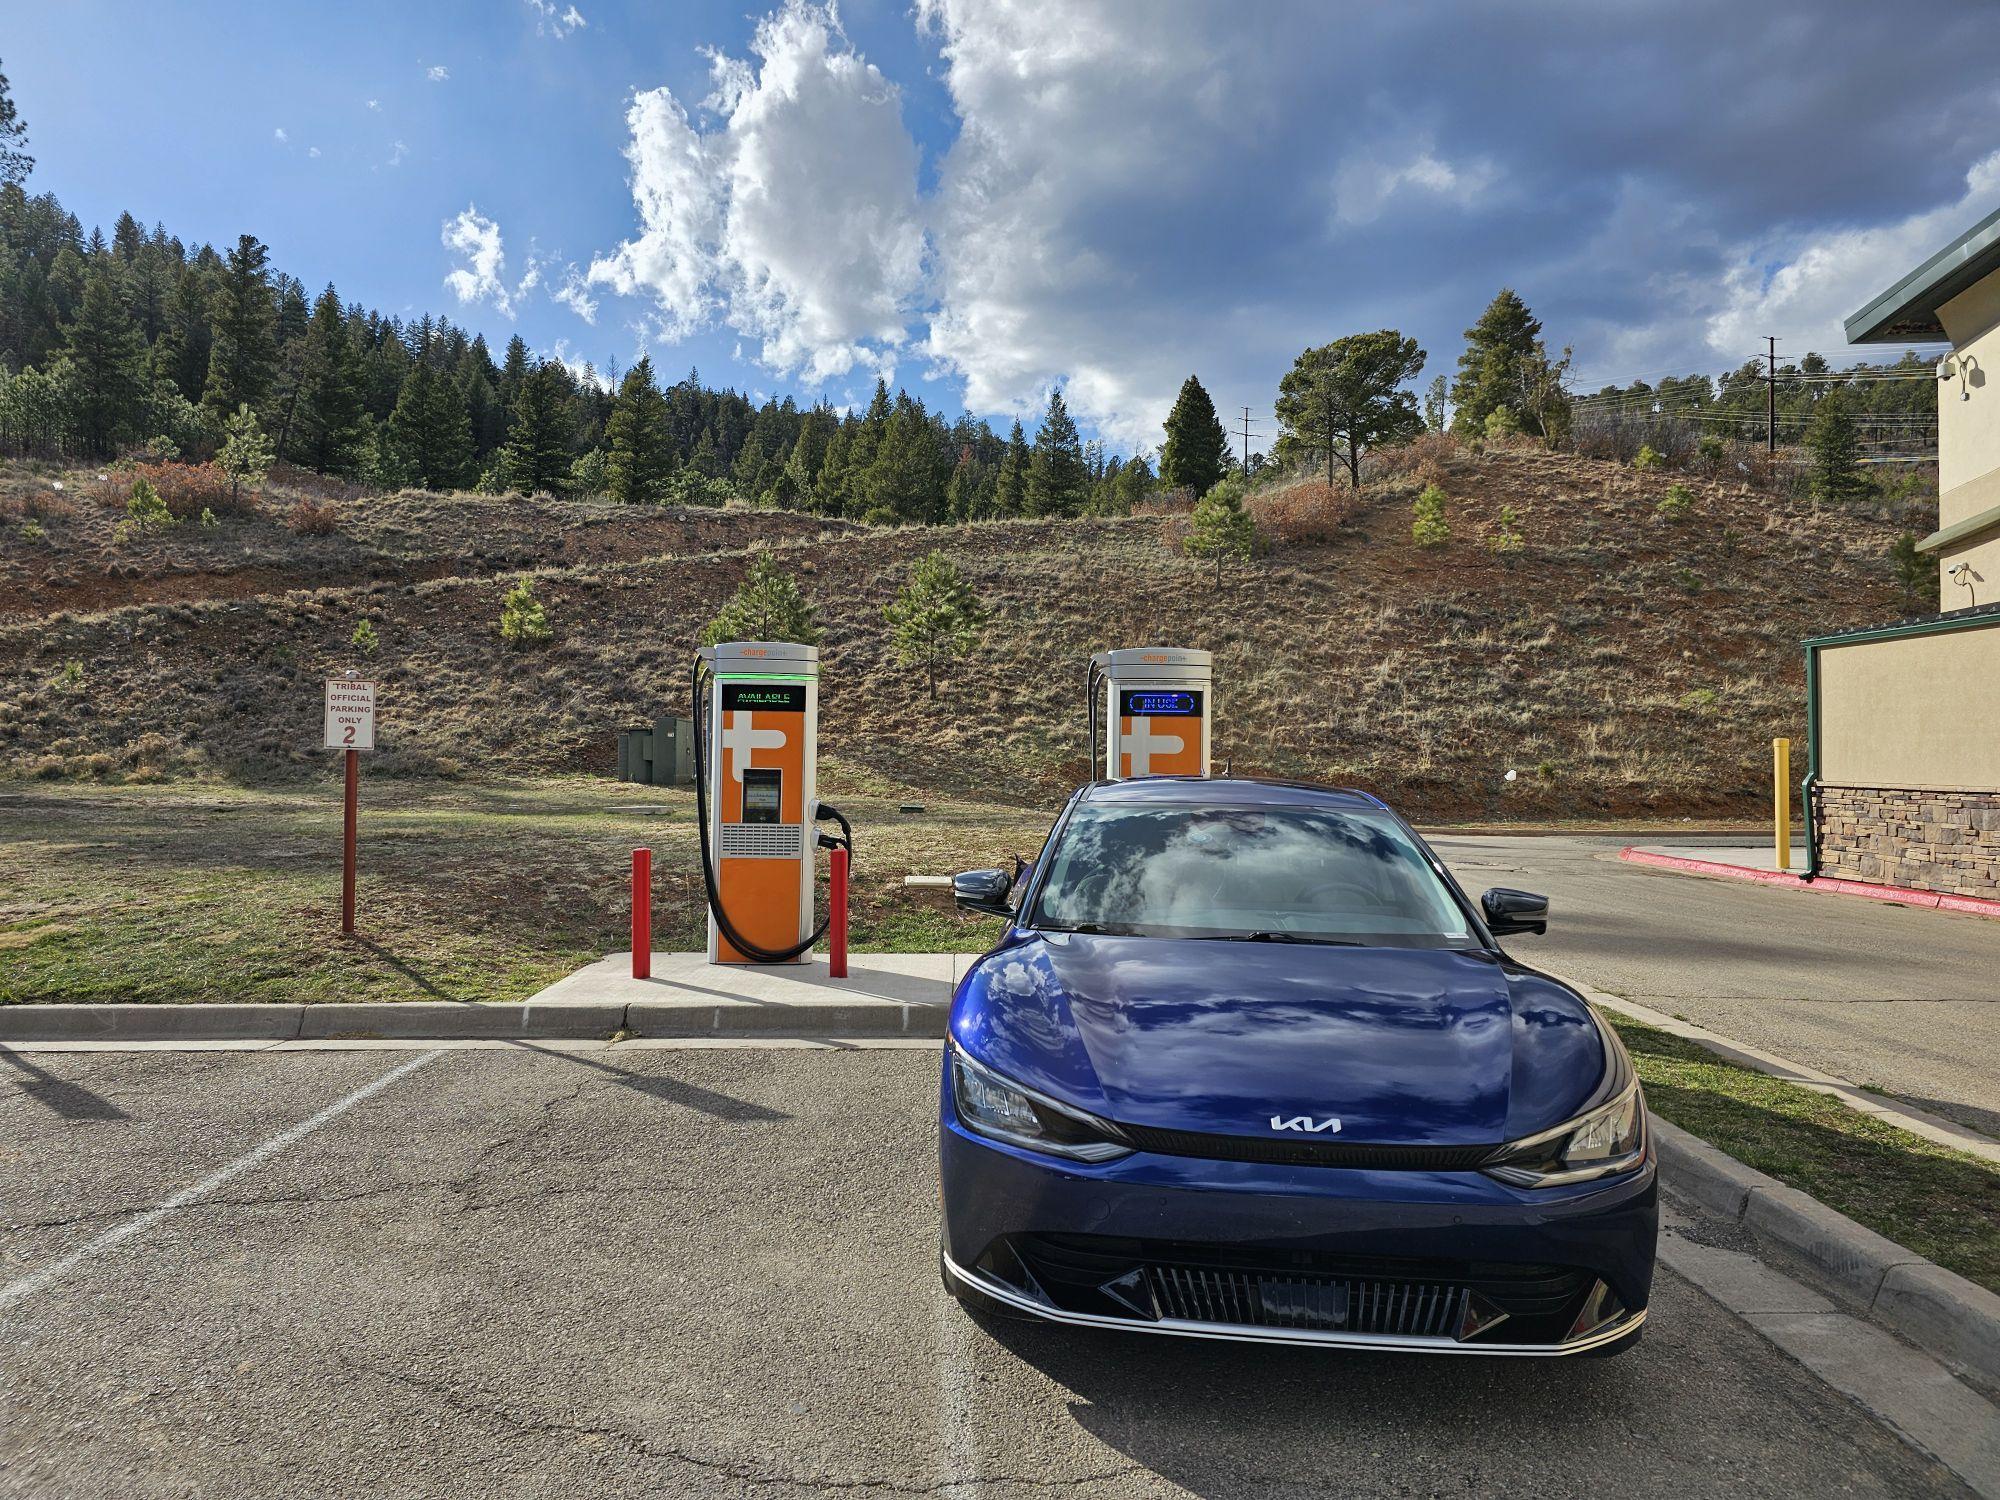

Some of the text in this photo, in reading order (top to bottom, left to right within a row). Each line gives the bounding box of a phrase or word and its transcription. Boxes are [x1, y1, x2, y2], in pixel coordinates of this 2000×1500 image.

[330, 694, 372, 702] OFFICIAL
[1144, 698, 1179, 709] IN USE
[330, 705, 371, 713] PARKING
[338, 716, 363, 724] ONLY
[342, 725, 356, 744] 2
[1270, 1115, 1342, 1134] KIA
